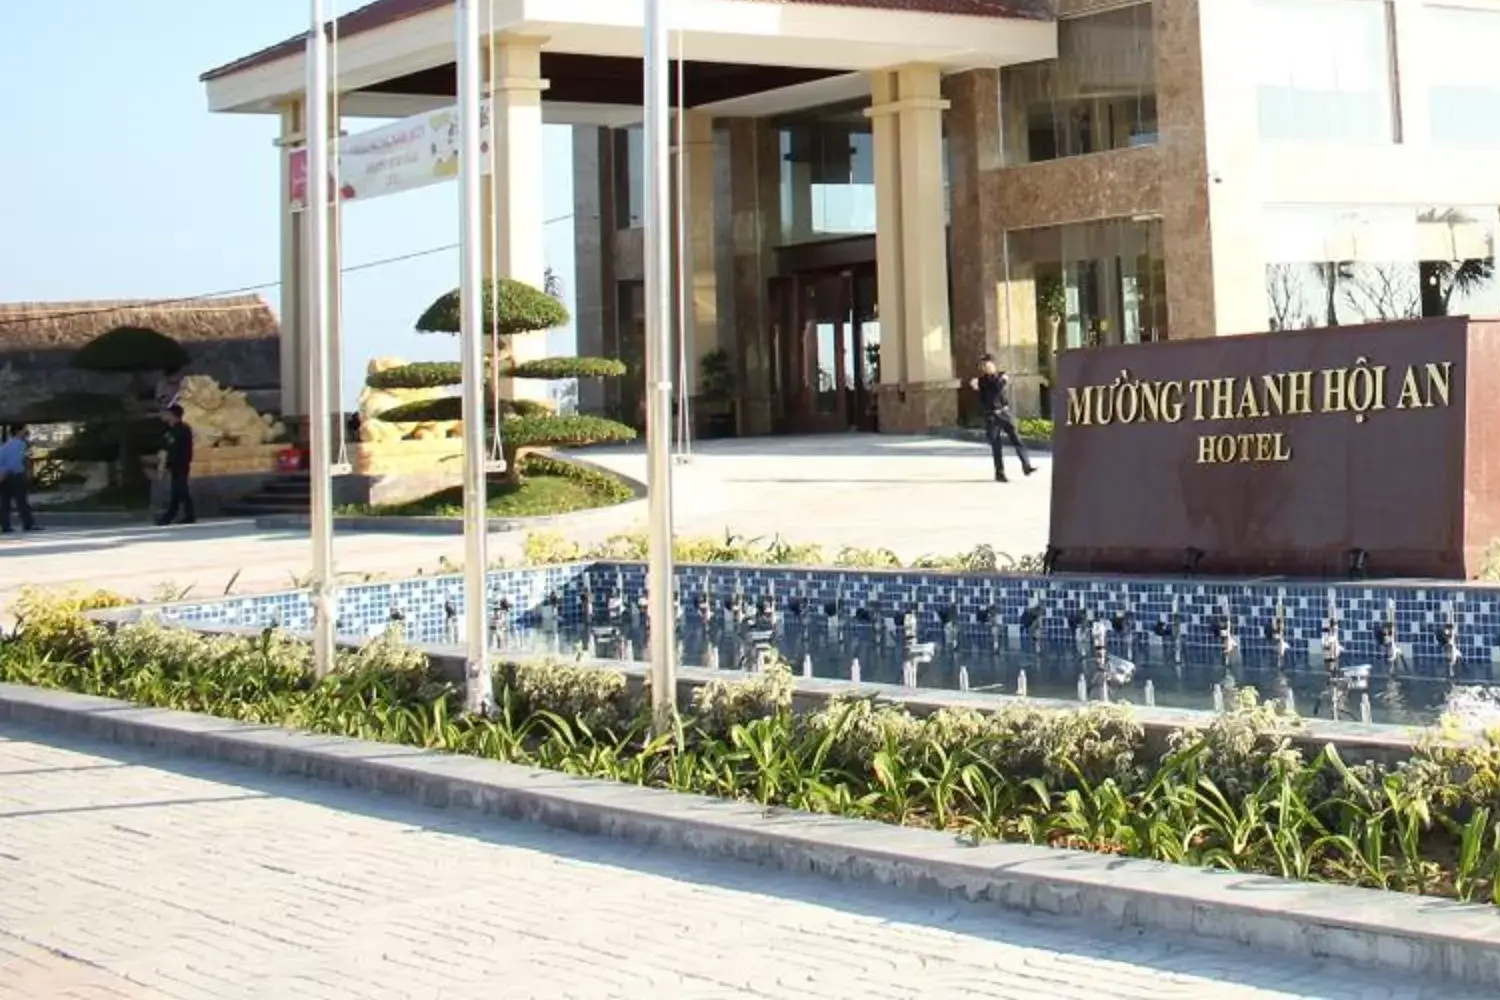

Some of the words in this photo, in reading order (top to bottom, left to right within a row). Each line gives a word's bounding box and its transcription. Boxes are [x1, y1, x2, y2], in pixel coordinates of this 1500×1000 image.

[1065, 368, 1184, 426] MƯỜNG
[1189, 374, 1313, 422] THANH
[1321, 356, 1387, 423] HỘI
[1396, 361, 1452, 409] AN
[1196, 432, 1292, 463] HOTEL
